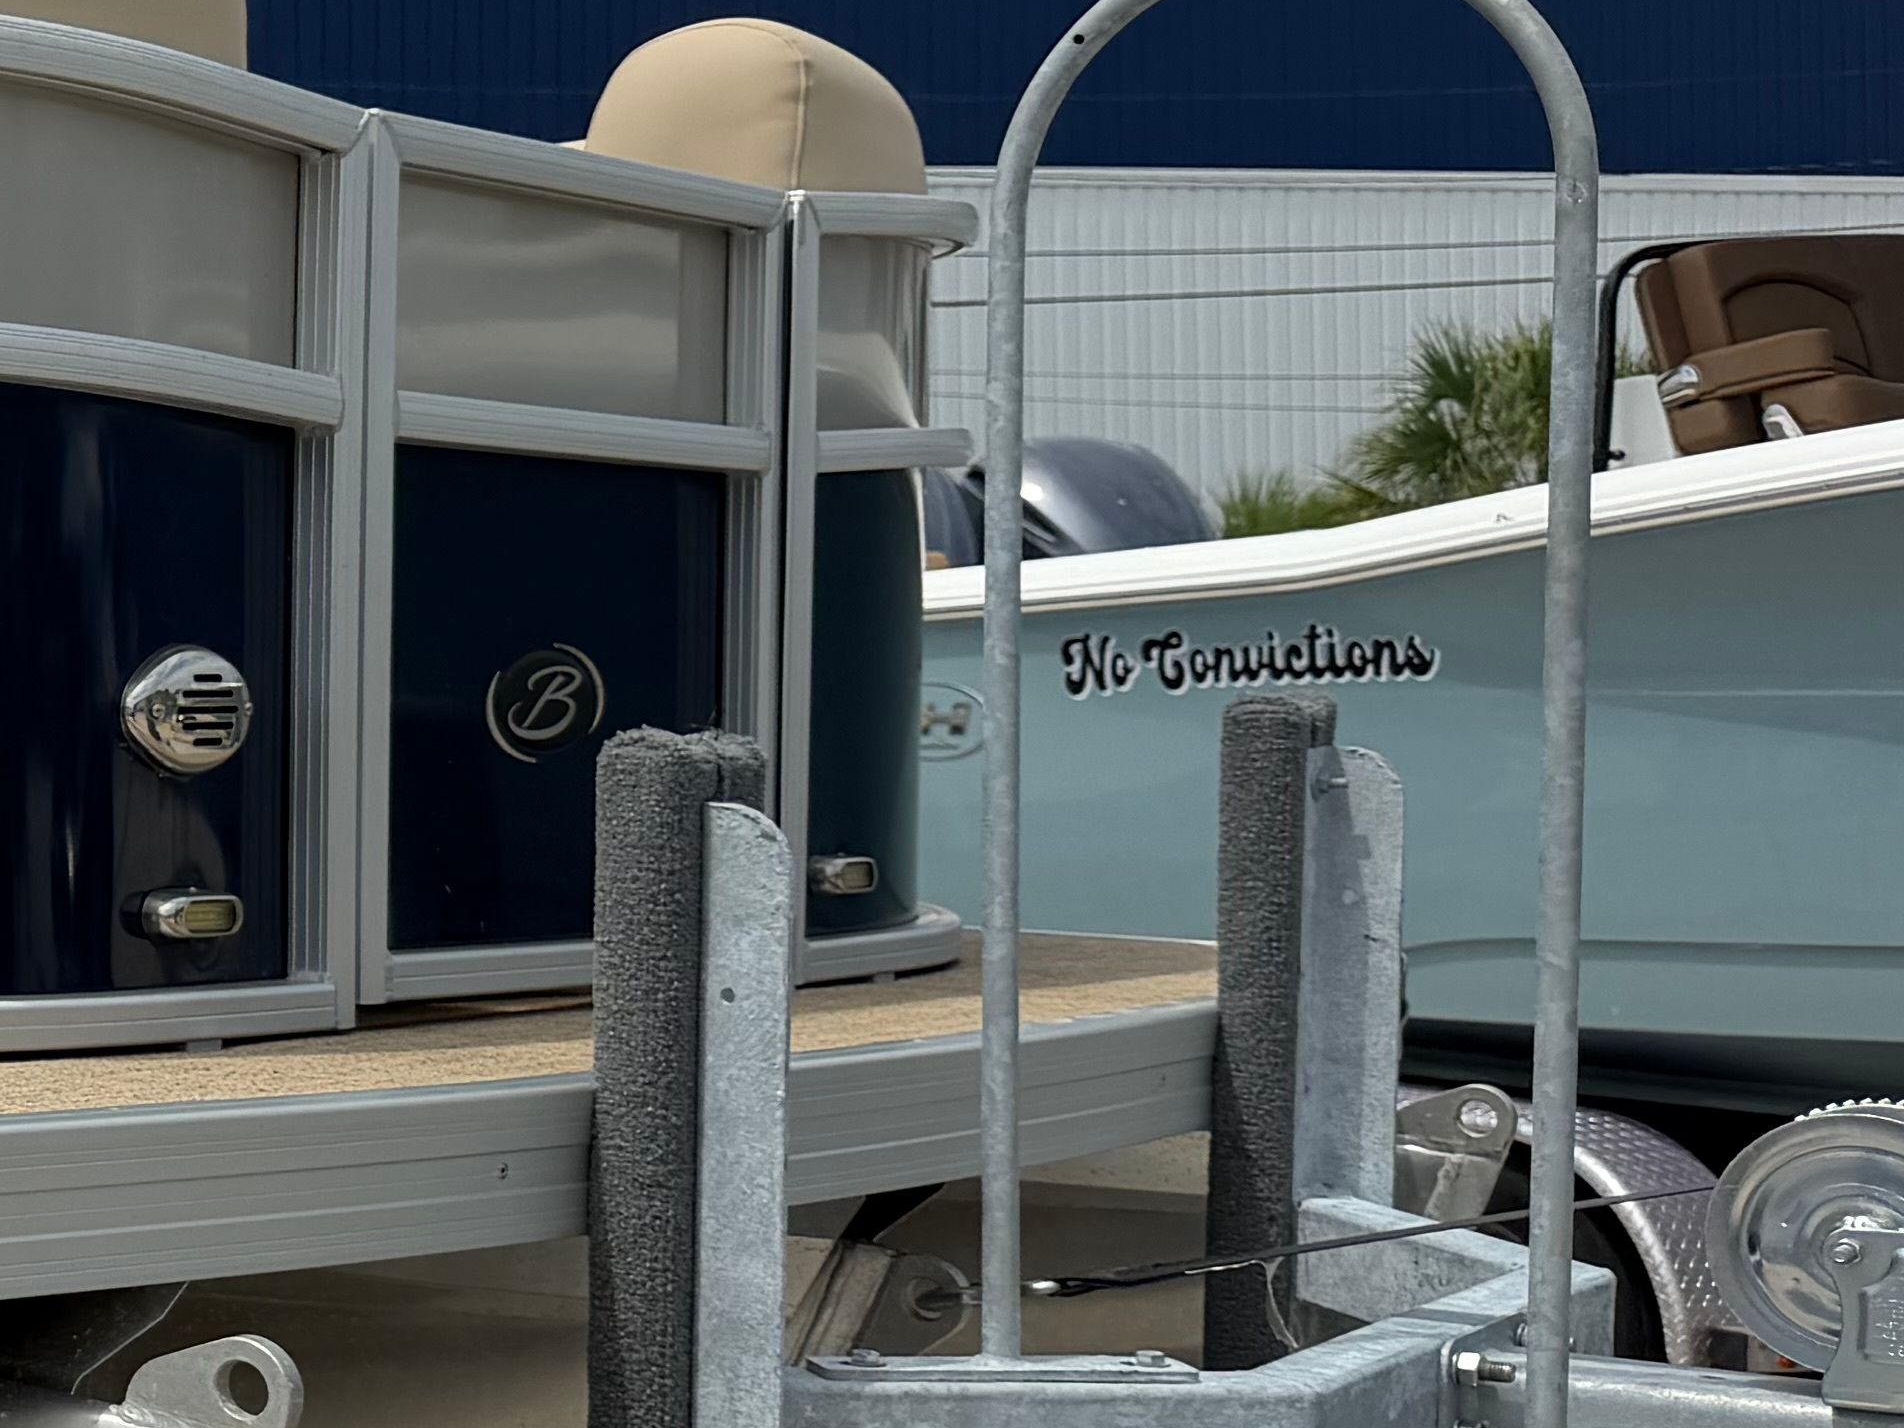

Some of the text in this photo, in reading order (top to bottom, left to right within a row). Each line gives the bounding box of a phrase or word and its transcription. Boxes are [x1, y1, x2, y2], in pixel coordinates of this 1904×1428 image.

[1061, 622, 1439, 699] No Convictions
[507, 665, 582, 740] B
